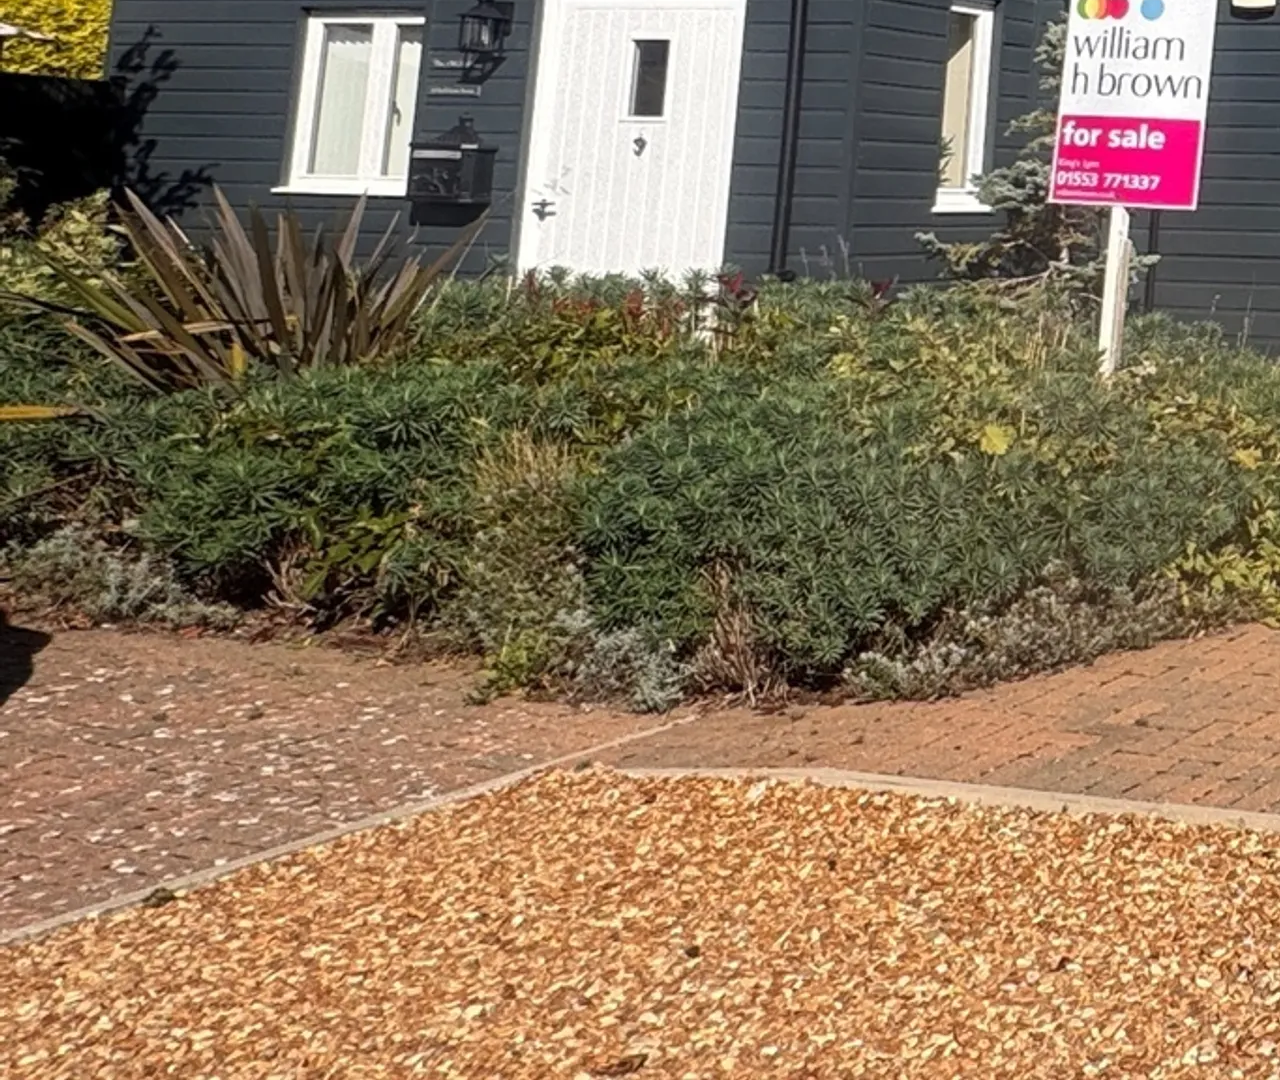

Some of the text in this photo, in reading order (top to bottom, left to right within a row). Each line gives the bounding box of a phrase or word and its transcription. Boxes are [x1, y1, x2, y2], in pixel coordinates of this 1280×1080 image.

[1073, 26, 1185, 61] william
[1071, 62, 1202, 99] h brown
[1063, 121, 1166, 149] for sale
[1057, 171, 1161, 190] 01553 771337
